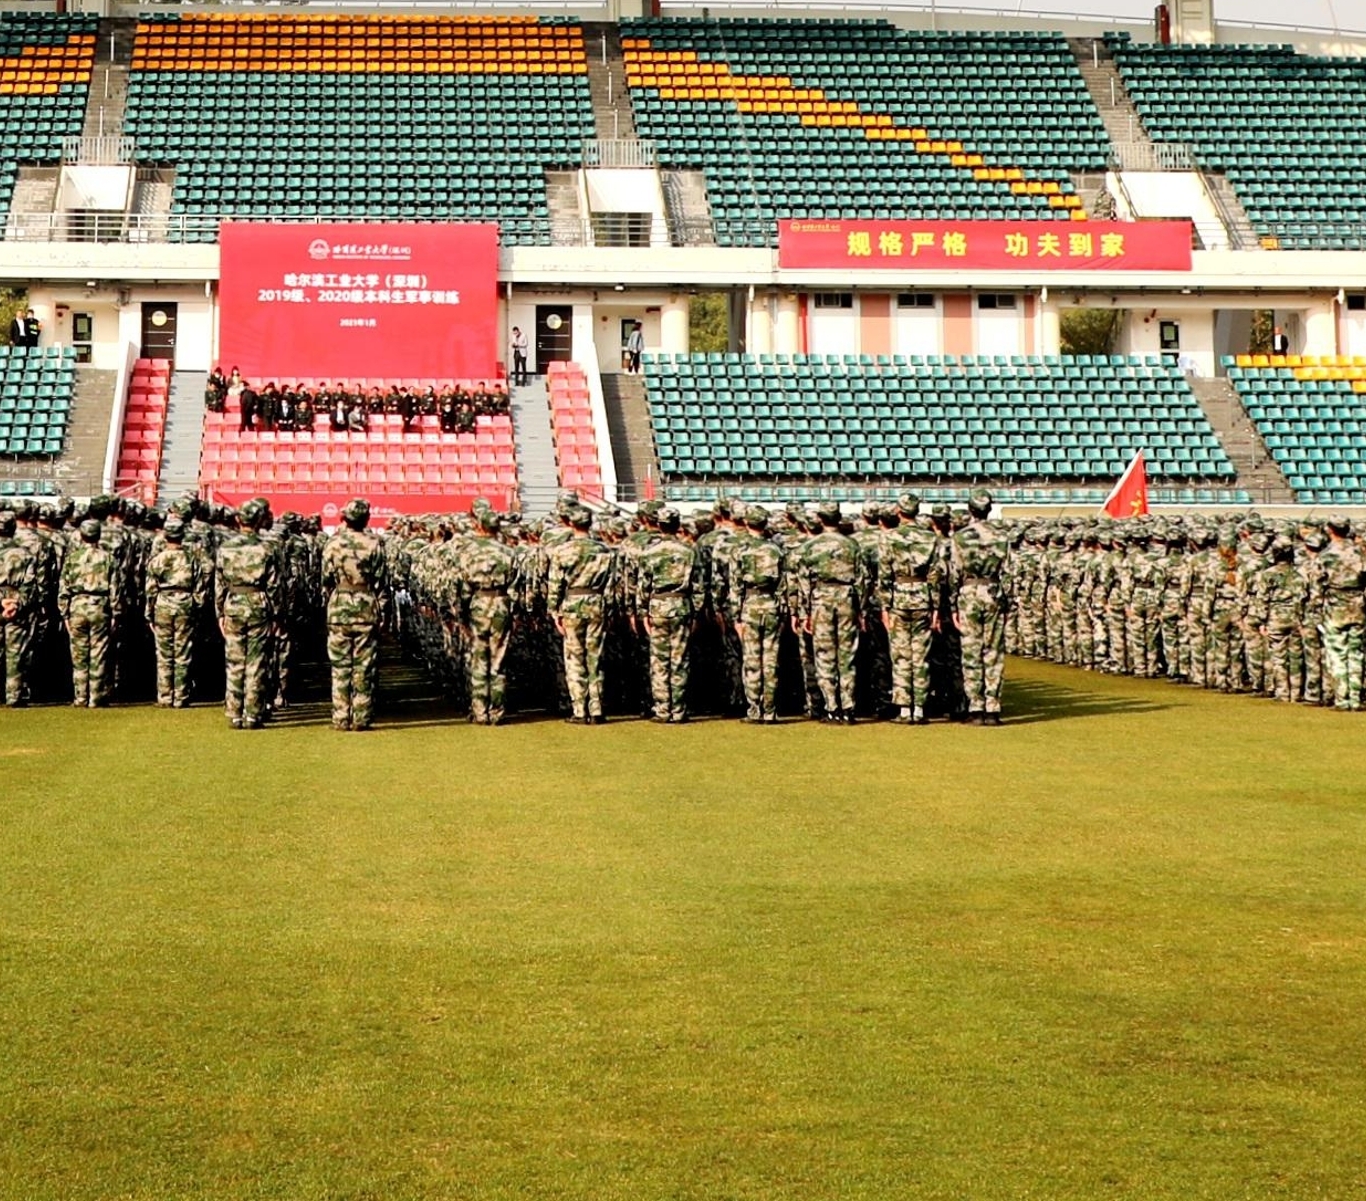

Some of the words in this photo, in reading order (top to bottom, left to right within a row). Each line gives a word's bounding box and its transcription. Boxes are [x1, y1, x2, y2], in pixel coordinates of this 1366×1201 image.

[847, 231, 967, 257] 规格严格
[1005, 232, 1125, 257] 功夫到家
